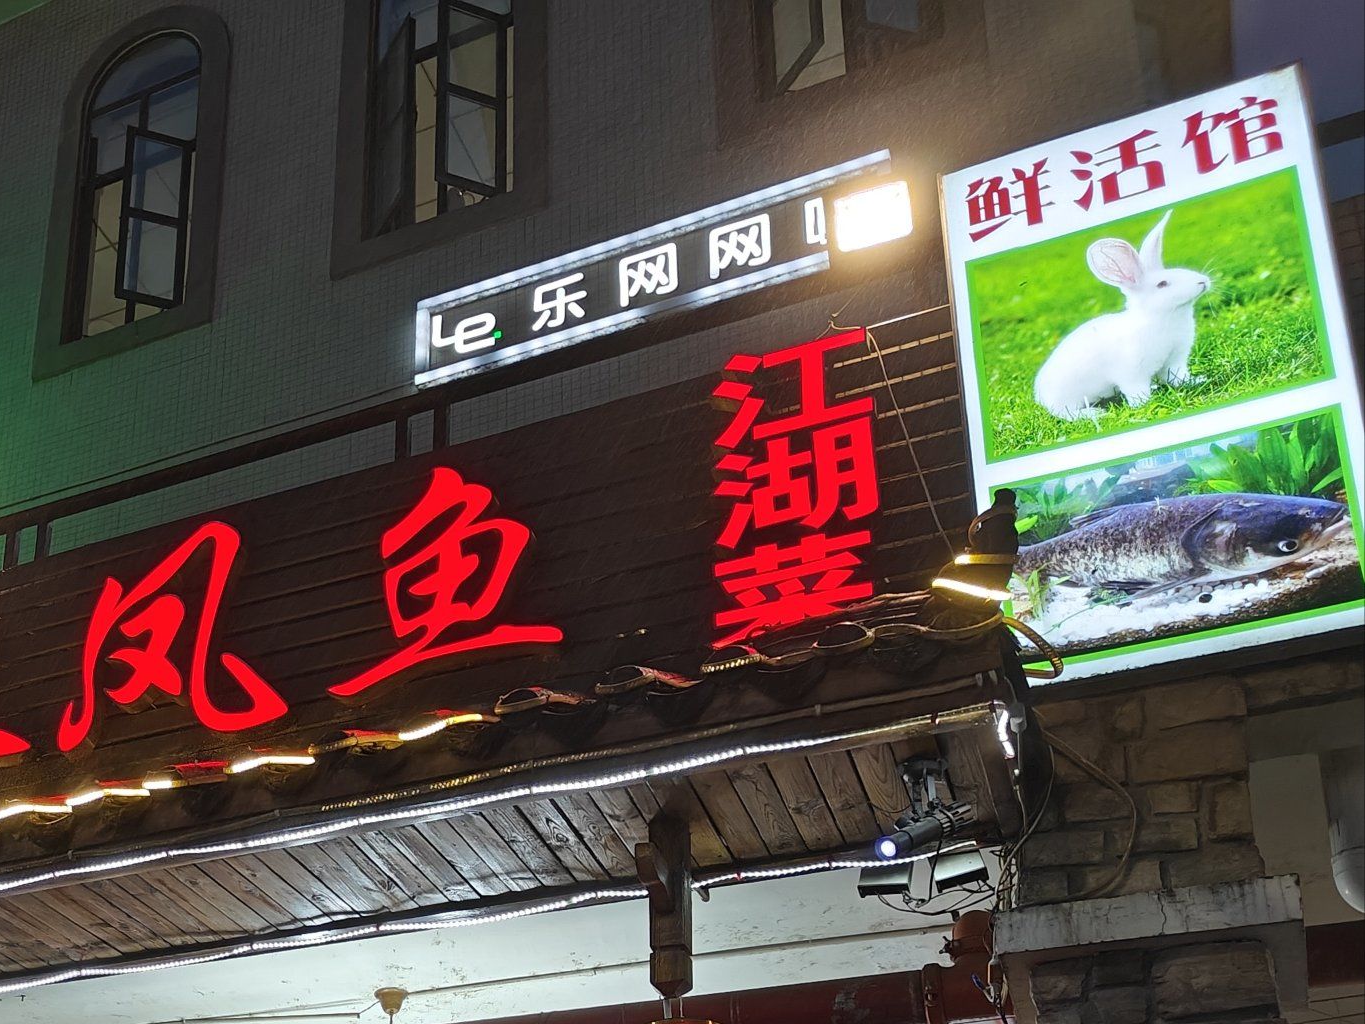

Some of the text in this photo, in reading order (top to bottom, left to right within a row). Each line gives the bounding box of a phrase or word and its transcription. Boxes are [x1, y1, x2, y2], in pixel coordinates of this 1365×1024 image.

[964, 97, 1283, 242] 鲜活馆
[712, 328, 880, 650] 江湖菜
